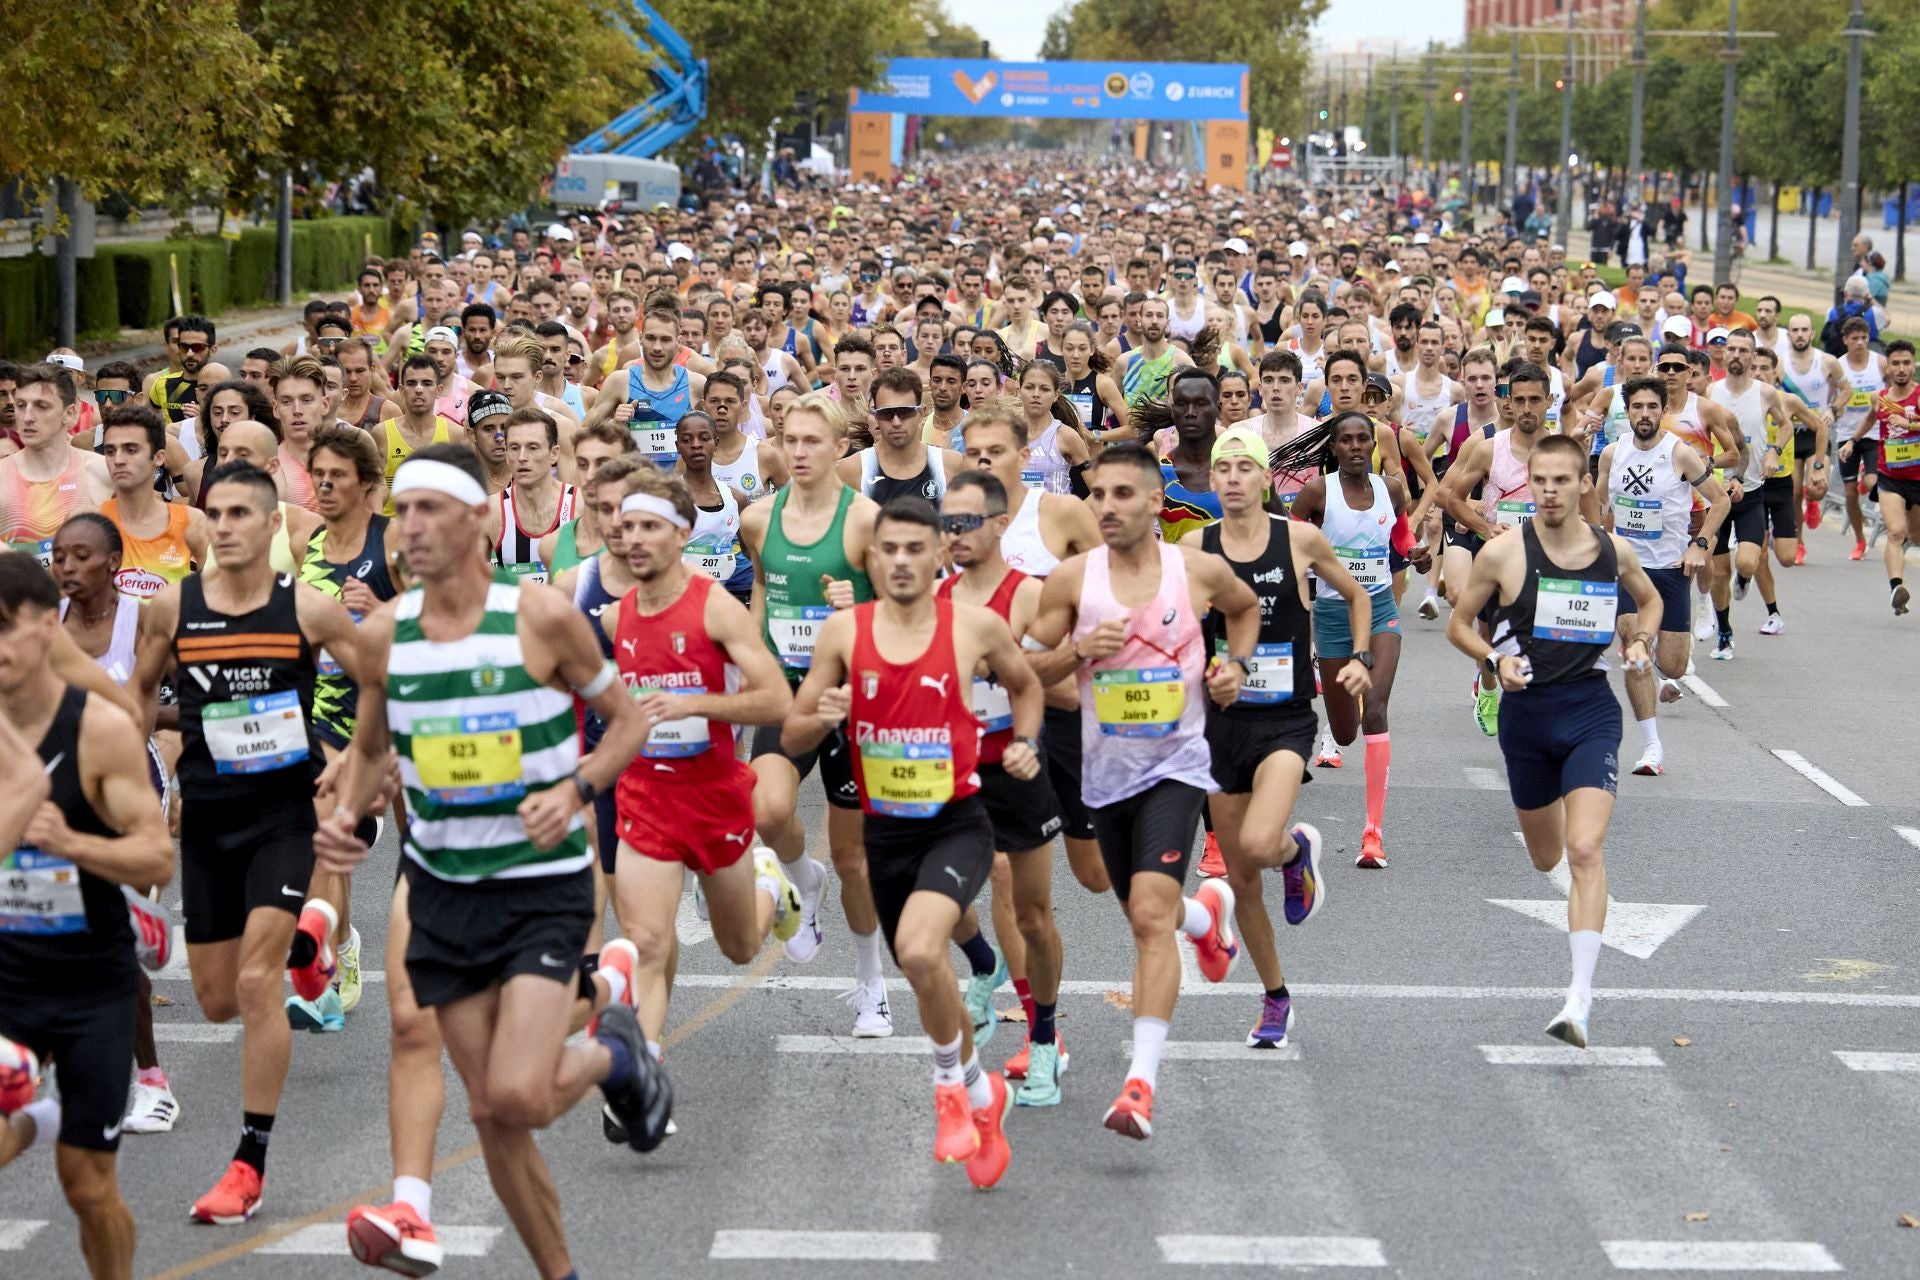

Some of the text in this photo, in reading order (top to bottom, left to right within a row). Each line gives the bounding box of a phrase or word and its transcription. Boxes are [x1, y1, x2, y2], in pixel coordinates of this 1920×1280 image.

[1187, 86, 1234, 98] ZURICH
[650, 433, 665, 441] 119
[1637, 464, 1645, 473] T
[1629, 511, 1643, 519] 122
[1627, 521, 1646, 529] Paddy
[702, 559, 719, 567] 207
[1348, 562, 1366, 571] 203
[118, 574, 164, 593] Serrano
[1352, 575, 1377, 583] KURUI
[1568, 600, 1589, 612] 102
[1555, 616, 1598, 628] Tomislav
[791, 625, 812, 636] 110
[222, 667, 273, 682] VICKY
[640, 671, 702, 689] navarra
[229, 680, 271, 692] FOODS
[1125, 689, 1150, 702] 603
[1121, 709, 1158, 720] Jairo P
[243, 721, 261, 735] 61
[877, 726, 951, 744] navarra
[236, 740, 277, 755] OLMOS
[890, 766, 917, 779] 426
[880, 786, 933, 798] Francisco
